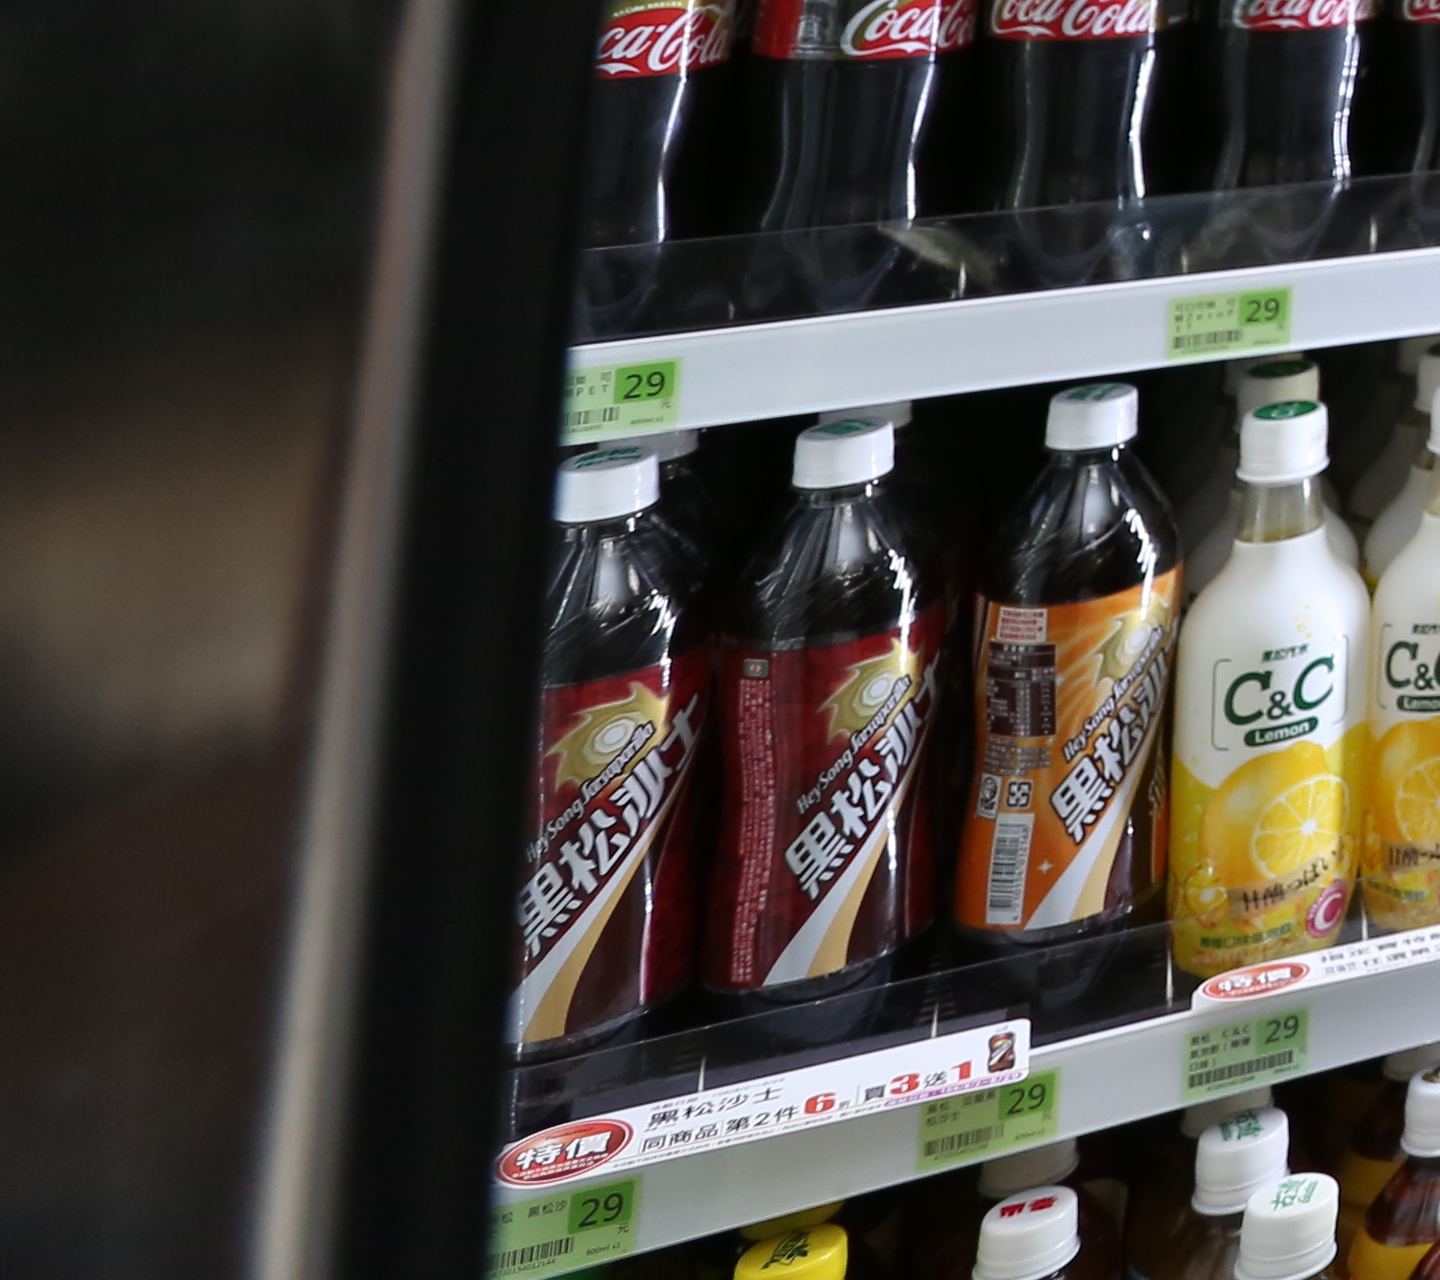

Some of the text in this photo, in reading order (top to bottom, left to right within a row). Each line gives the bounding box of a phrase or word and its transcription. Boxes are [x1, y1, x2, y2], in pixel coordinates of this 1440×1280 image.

[598, 6, 730, 75] ca-Cola
[1244, 298, 1281, 323] 29
[623, 371, 665, 400] 29
[1223, 653, 1336, 726] C&C
[1049, 647, 1170, 847] 黑松沙
[1062, 695, 1117, 763] Hey Song
[1254, 721, 1311, 744] Lemon
[796, 782, 823, 814] Hey
[817, 748, 853, 792] Song
[519, 692, 699, 958] 黑松沙士
[547, 796, 585, 840] Song
[1266, 1015, 1300, 1042] 29
[648, 1086, 784, 1129] 黑松沙士
[1007, 1082, 1047, 1115] 29
[515, 1132, 612, 1172] 特價
[577, 1192, 625, 1229] 29
[617, 1222, 629, 1235] 元
